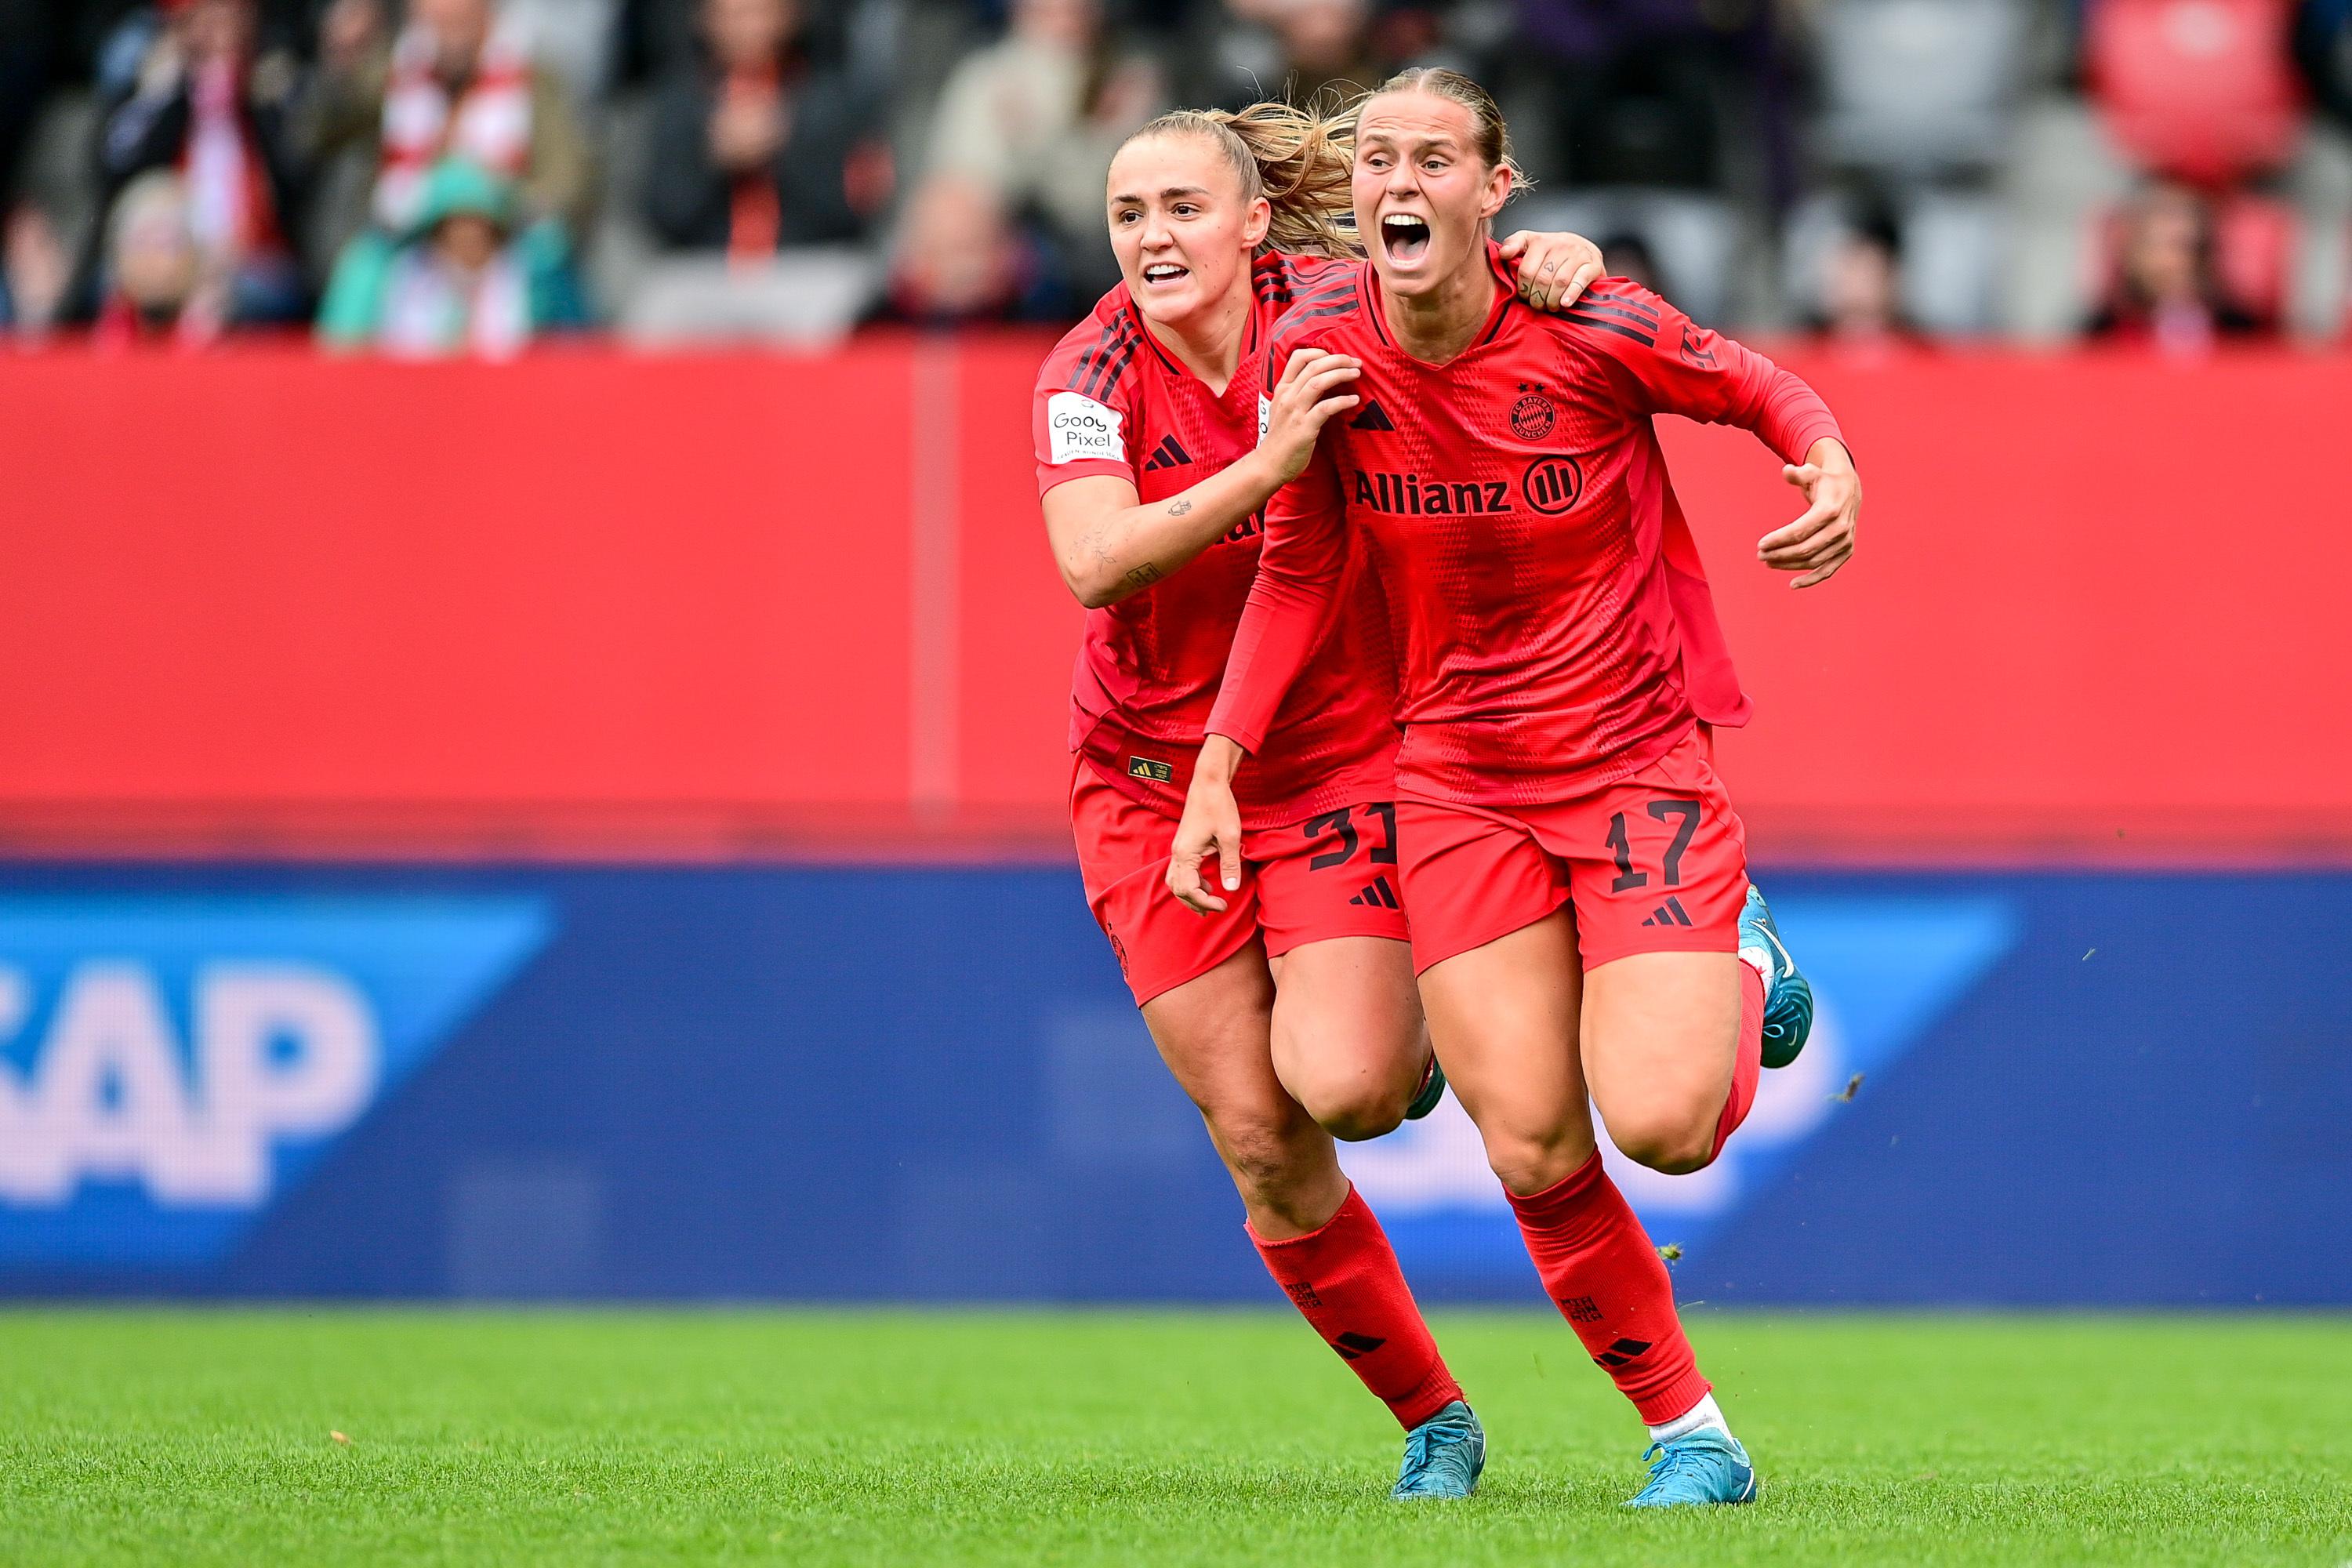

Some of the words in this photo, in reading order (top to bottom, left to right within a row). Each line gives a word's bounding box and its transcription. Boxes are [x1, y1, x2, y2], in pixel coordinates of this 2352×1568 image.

[1066, 431, 1111, 447] Pixel
[1353, 469, 1514, 515] Allianz
[1304, 801, 1398, 873] 31
[1605, 800, 1700, 894] 17
[0, 958, 381, 1209] AP
